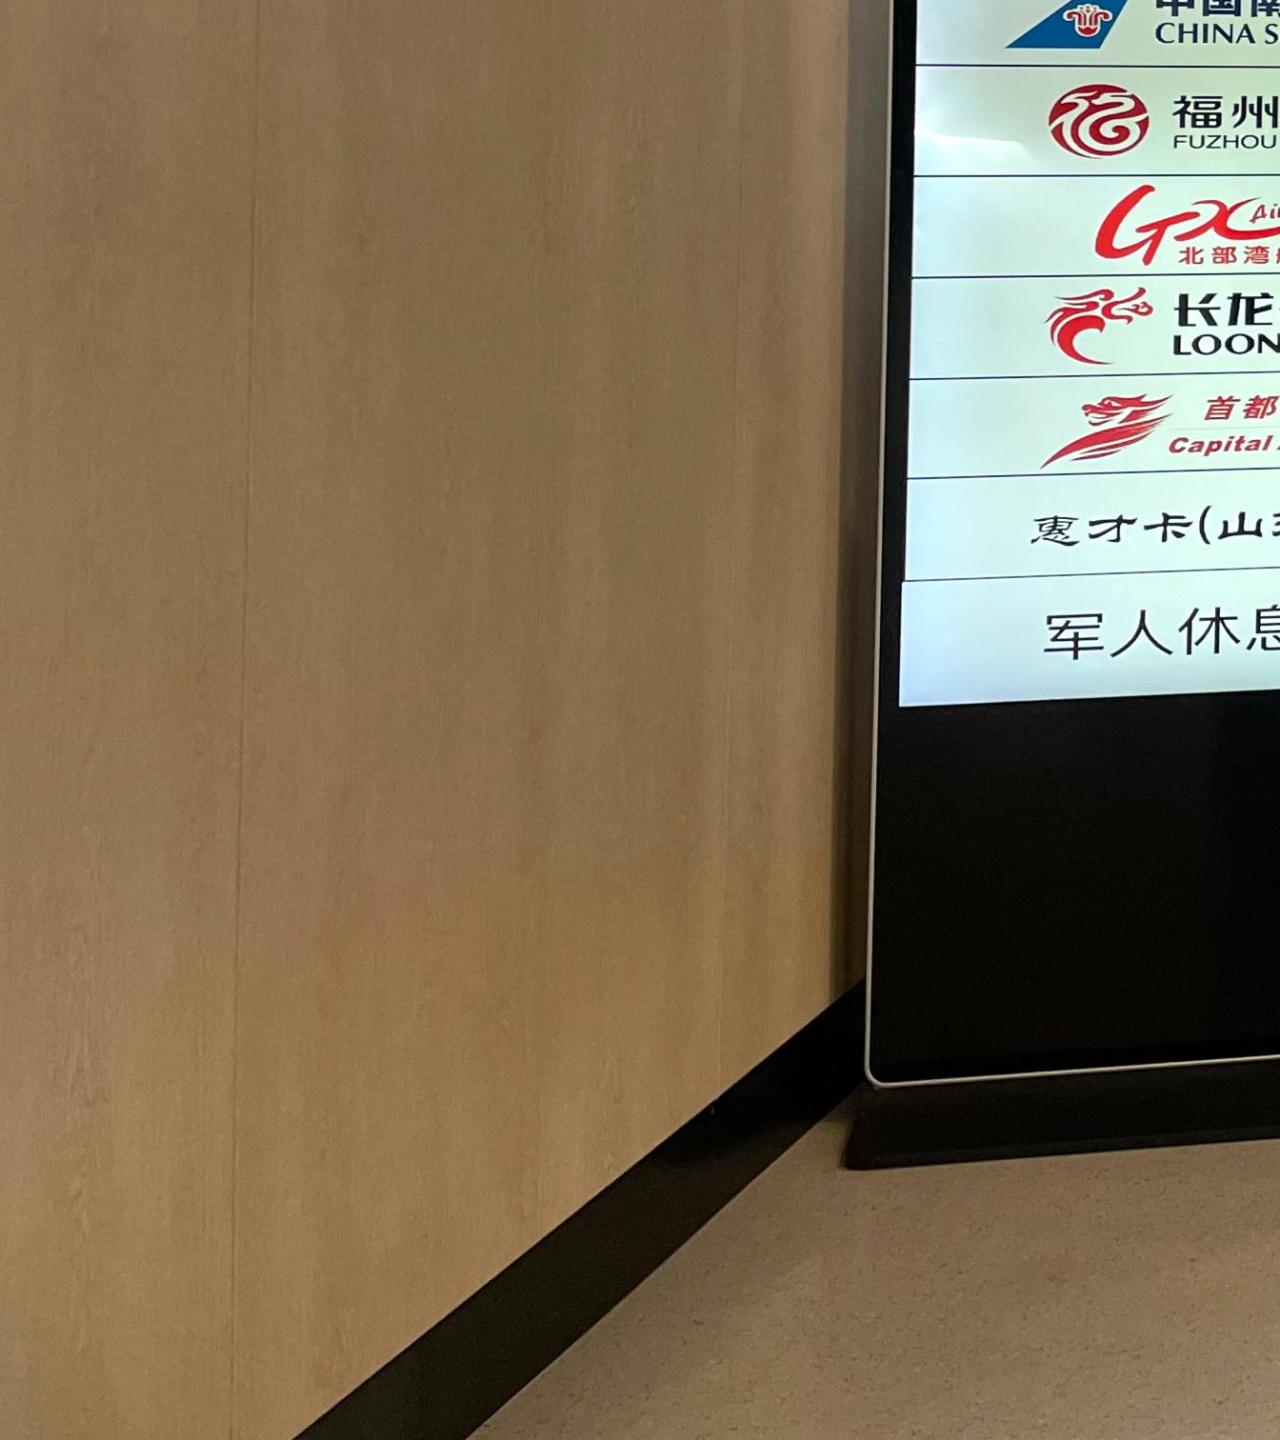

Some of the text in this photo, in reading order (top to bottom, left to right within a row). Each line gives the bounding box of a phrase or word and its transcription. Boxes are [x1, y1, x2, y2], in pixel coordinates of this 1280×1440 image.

[1155, 22, 1255, 45] CHINA
[1174, 134, 1277, 150] FUZHOU
[1168, 435, 1274, 457] Capital
